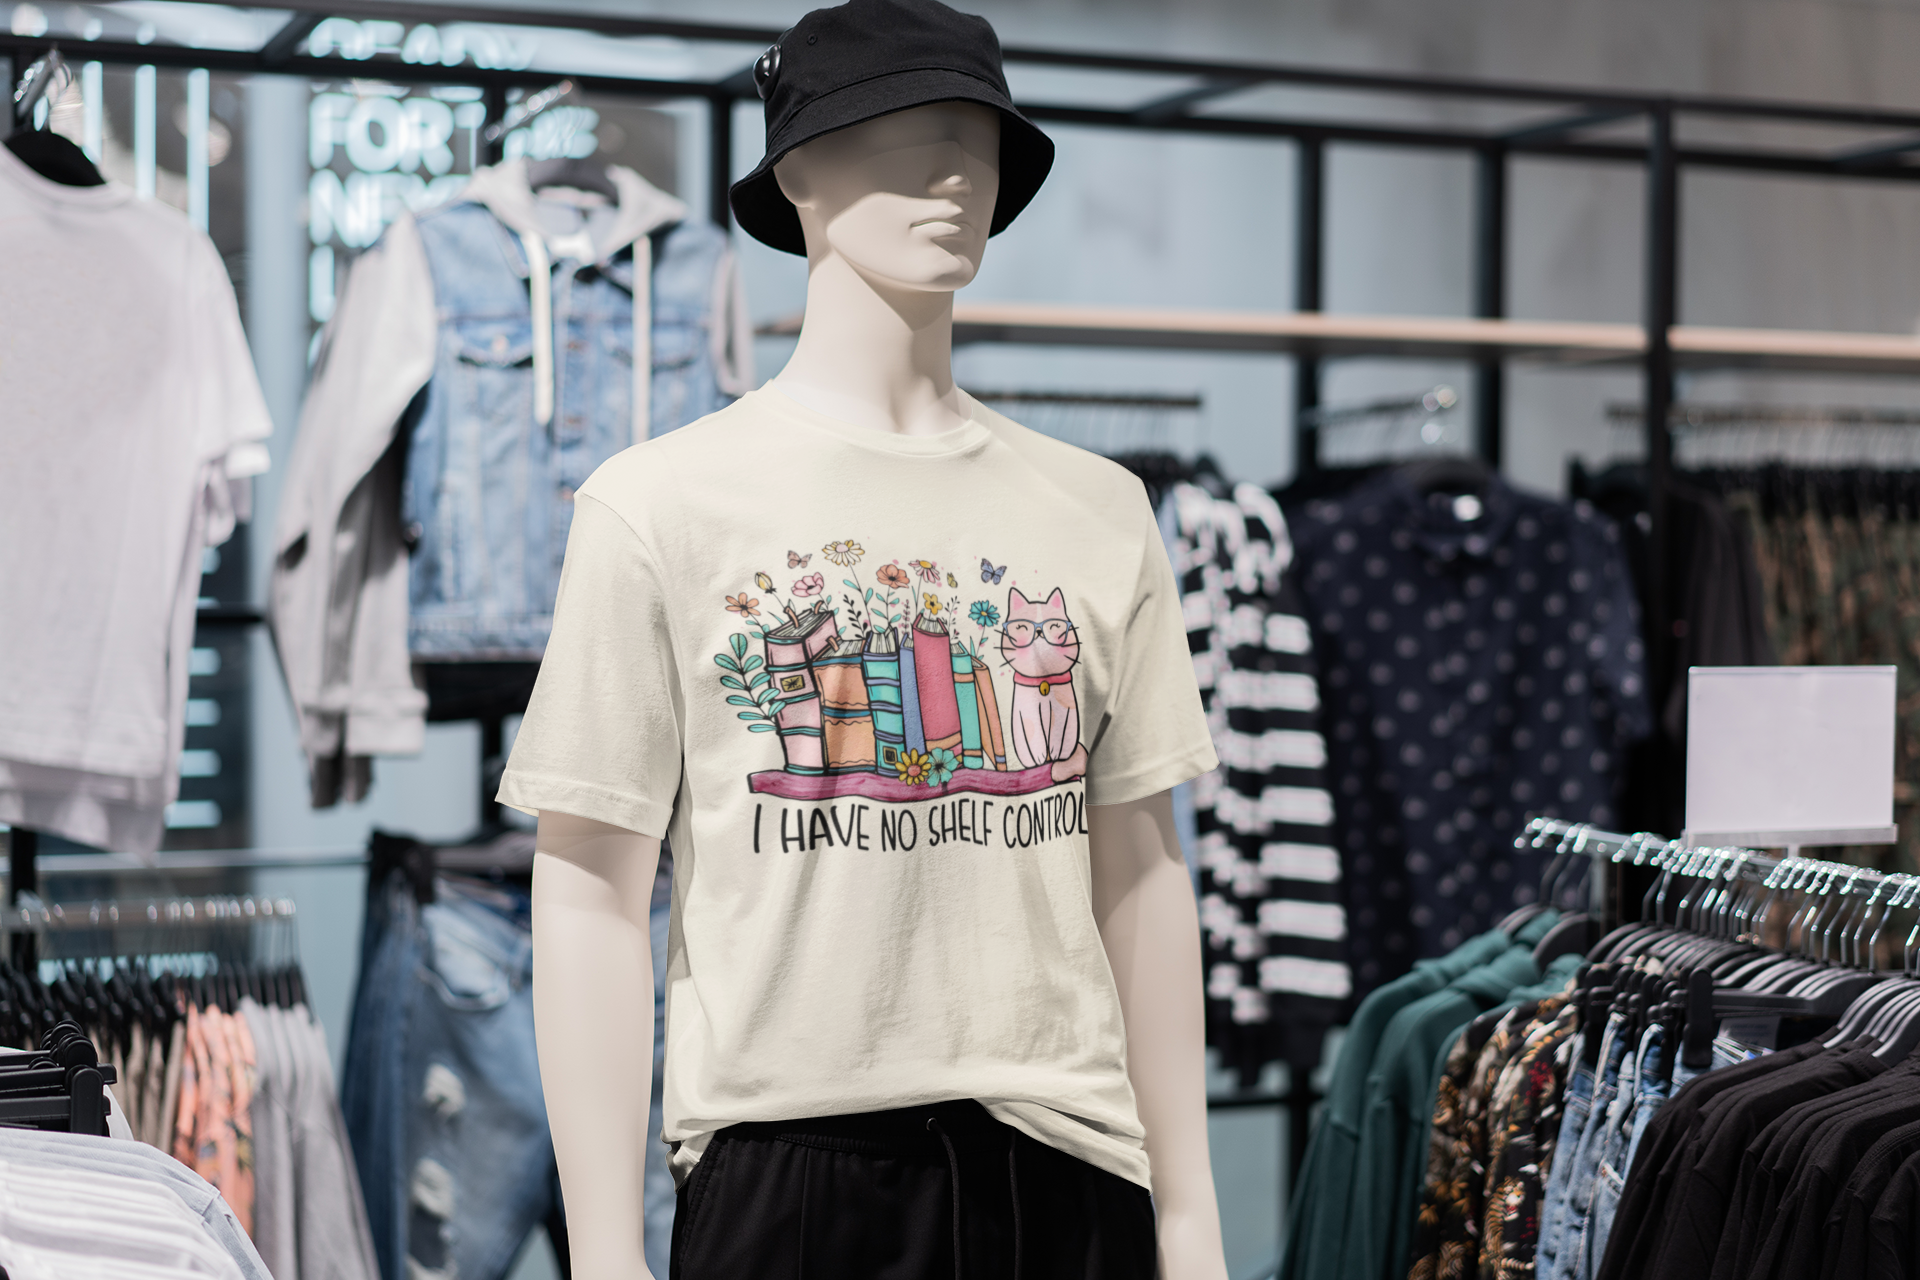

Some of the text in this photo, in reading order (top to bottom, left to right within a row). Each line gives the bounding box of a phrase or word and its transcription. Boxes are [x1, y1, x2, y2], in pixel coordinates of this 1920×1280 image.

[308, 92, 454, 176] FOR
[753, 790, 1089, 854] I HAVE NO SHELF CONTROL
